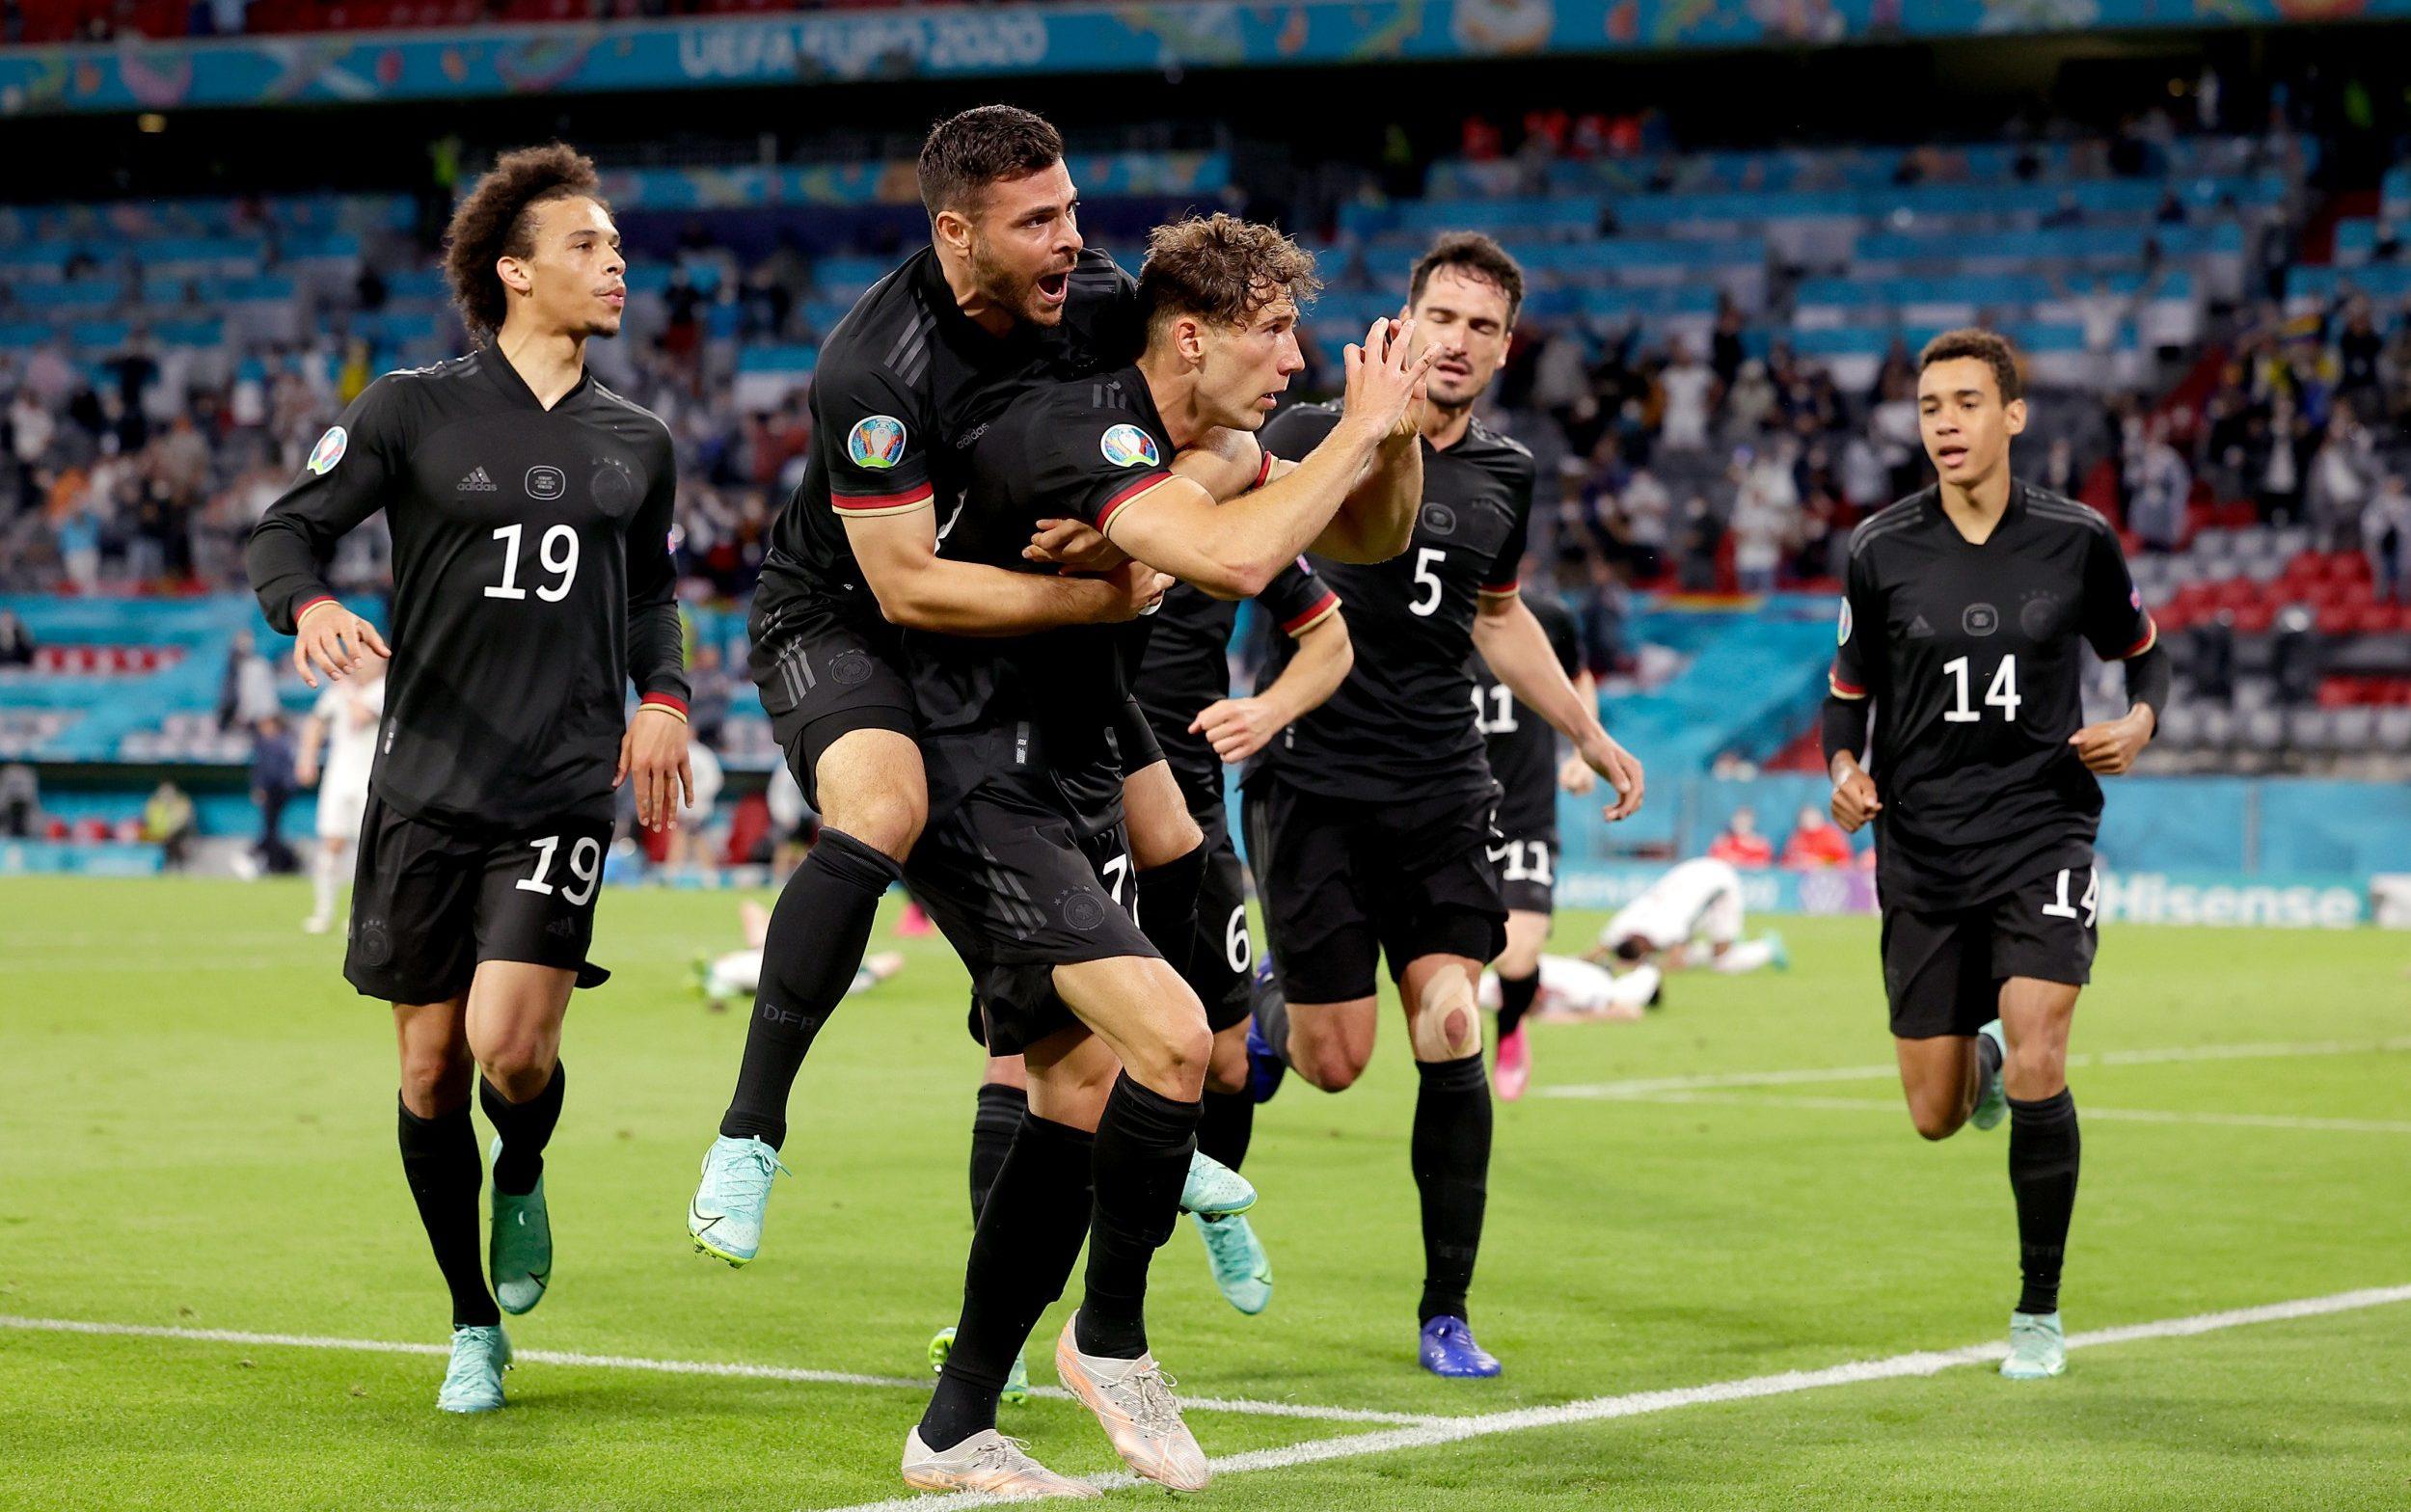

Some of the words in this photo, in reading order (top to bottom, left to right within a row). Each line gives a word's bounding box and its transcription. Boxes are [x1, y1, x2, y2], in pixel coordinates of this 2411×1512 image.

[679, 23, 795, 79] UEFA
[930, 12, 1048, 68] 2020
[956, 422, 989, 449] adidas
[456, 482, 498, 492] adidas
[484, 524, 580, 603] 19
[1408, 547, 1447, 617] 5
[1943, 654, 2021, 722] 14
[515, 835, 601, 905] 19
[1503, 839, 1554, 886] 11
[2042, 866, 2099, 929] 14
[2099, 871, 2361, 927] Hisense
[1226, 904, 1251, 974] 6
